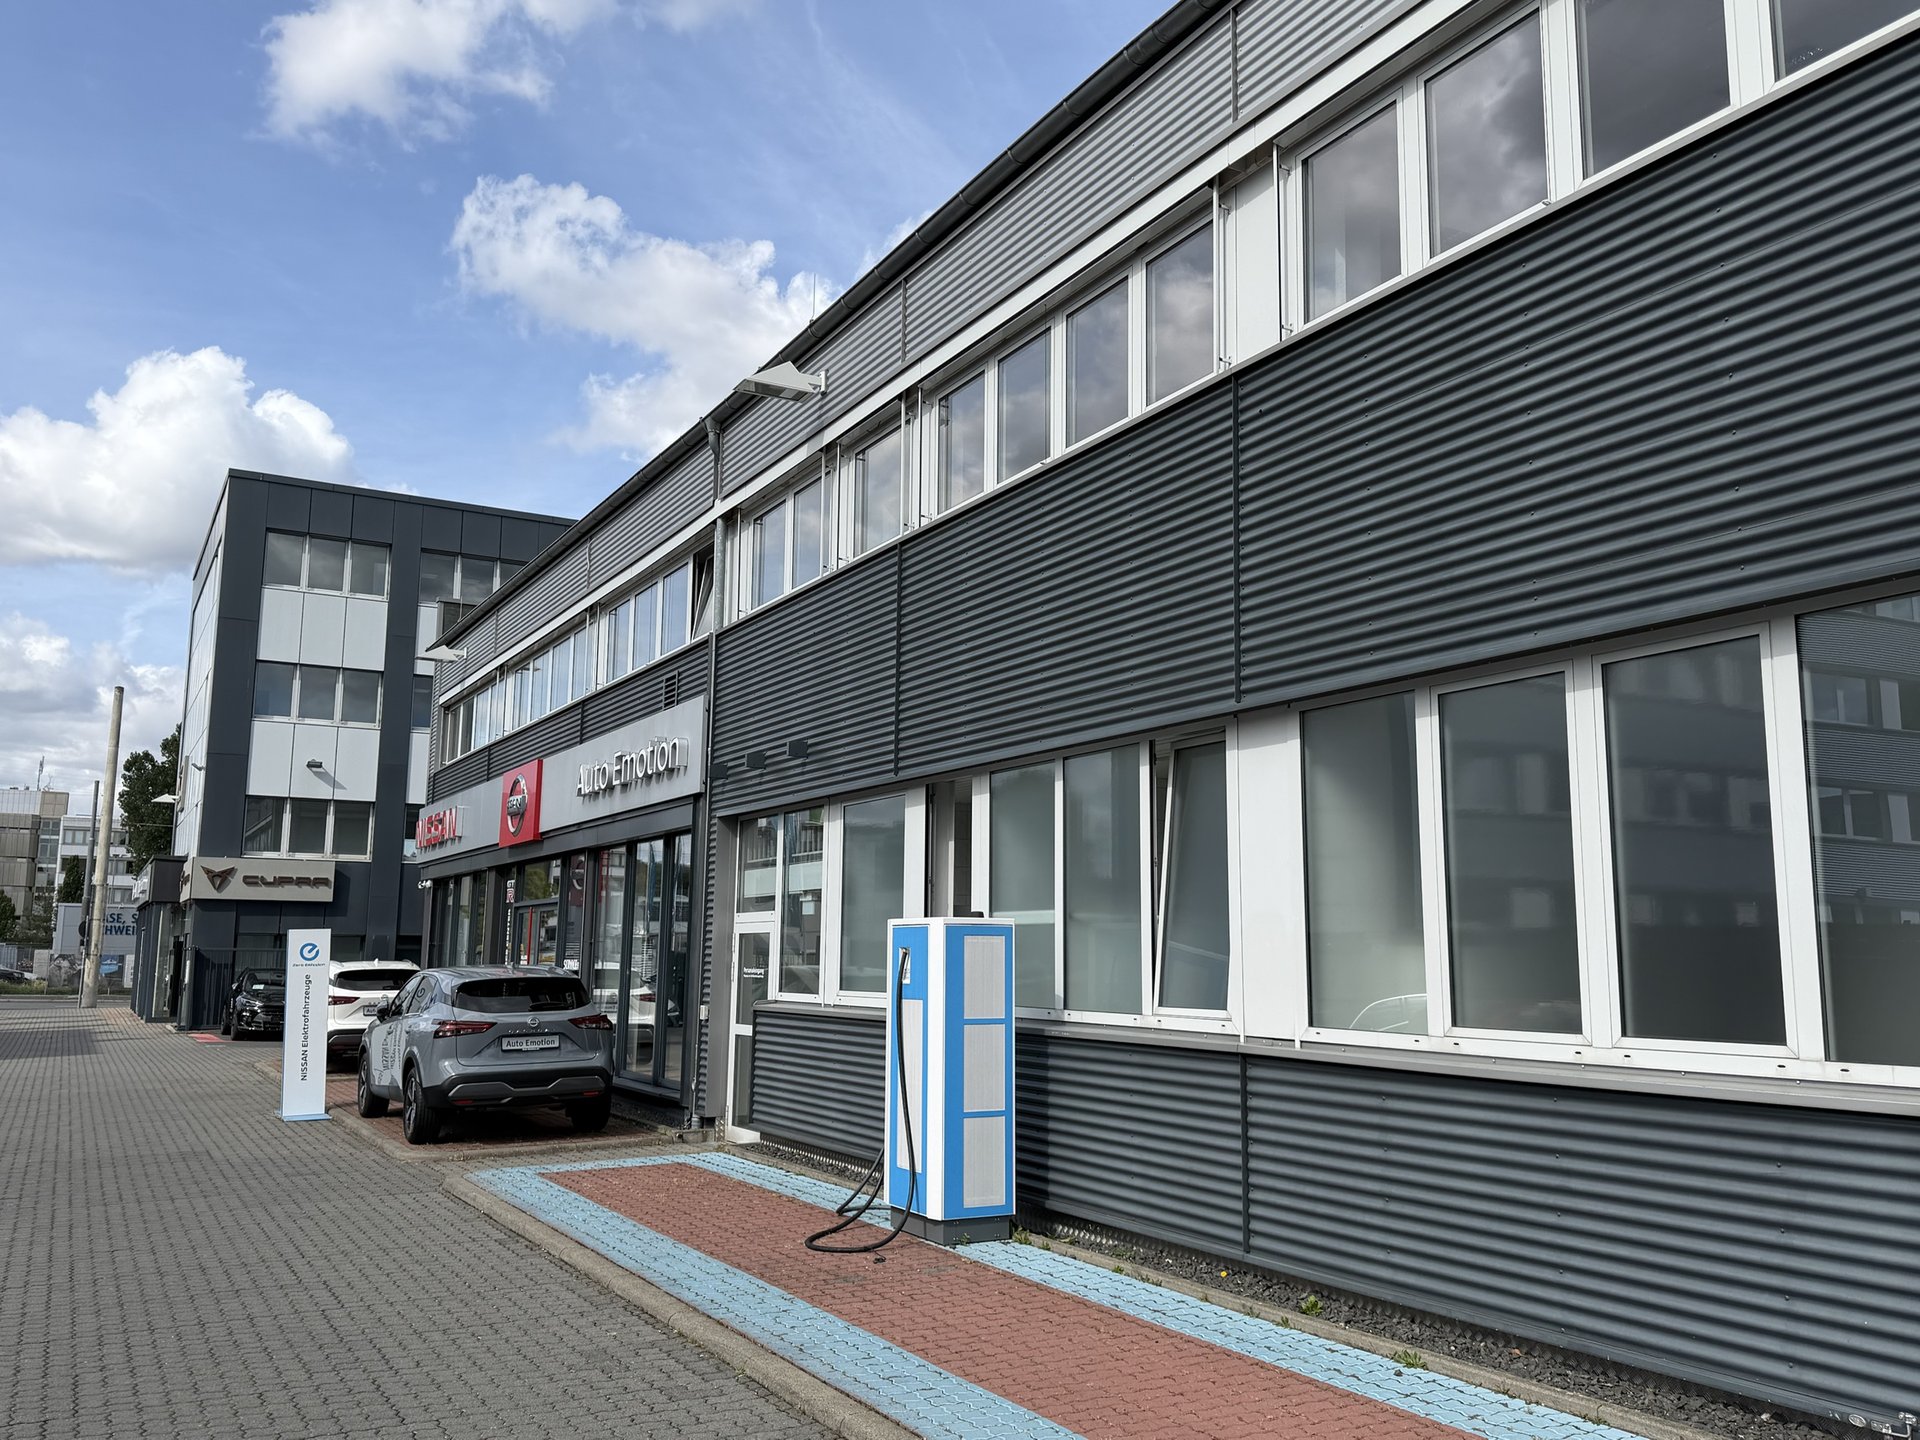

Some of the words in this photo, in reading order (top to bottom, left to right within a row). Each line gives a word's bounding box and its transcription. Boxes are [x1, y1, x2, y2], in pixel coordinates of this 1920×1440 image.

[577, 761, 609, 795] Auto
[612, 737, 680, 785] Emotion
[416, 806, 458, 849] NISSAN
[242, 875, 331, 888] CUPRA
[302, 974, 312, 1048] Elektrofahrzeuge
[525, 1038, 555, 1046] Emotion
